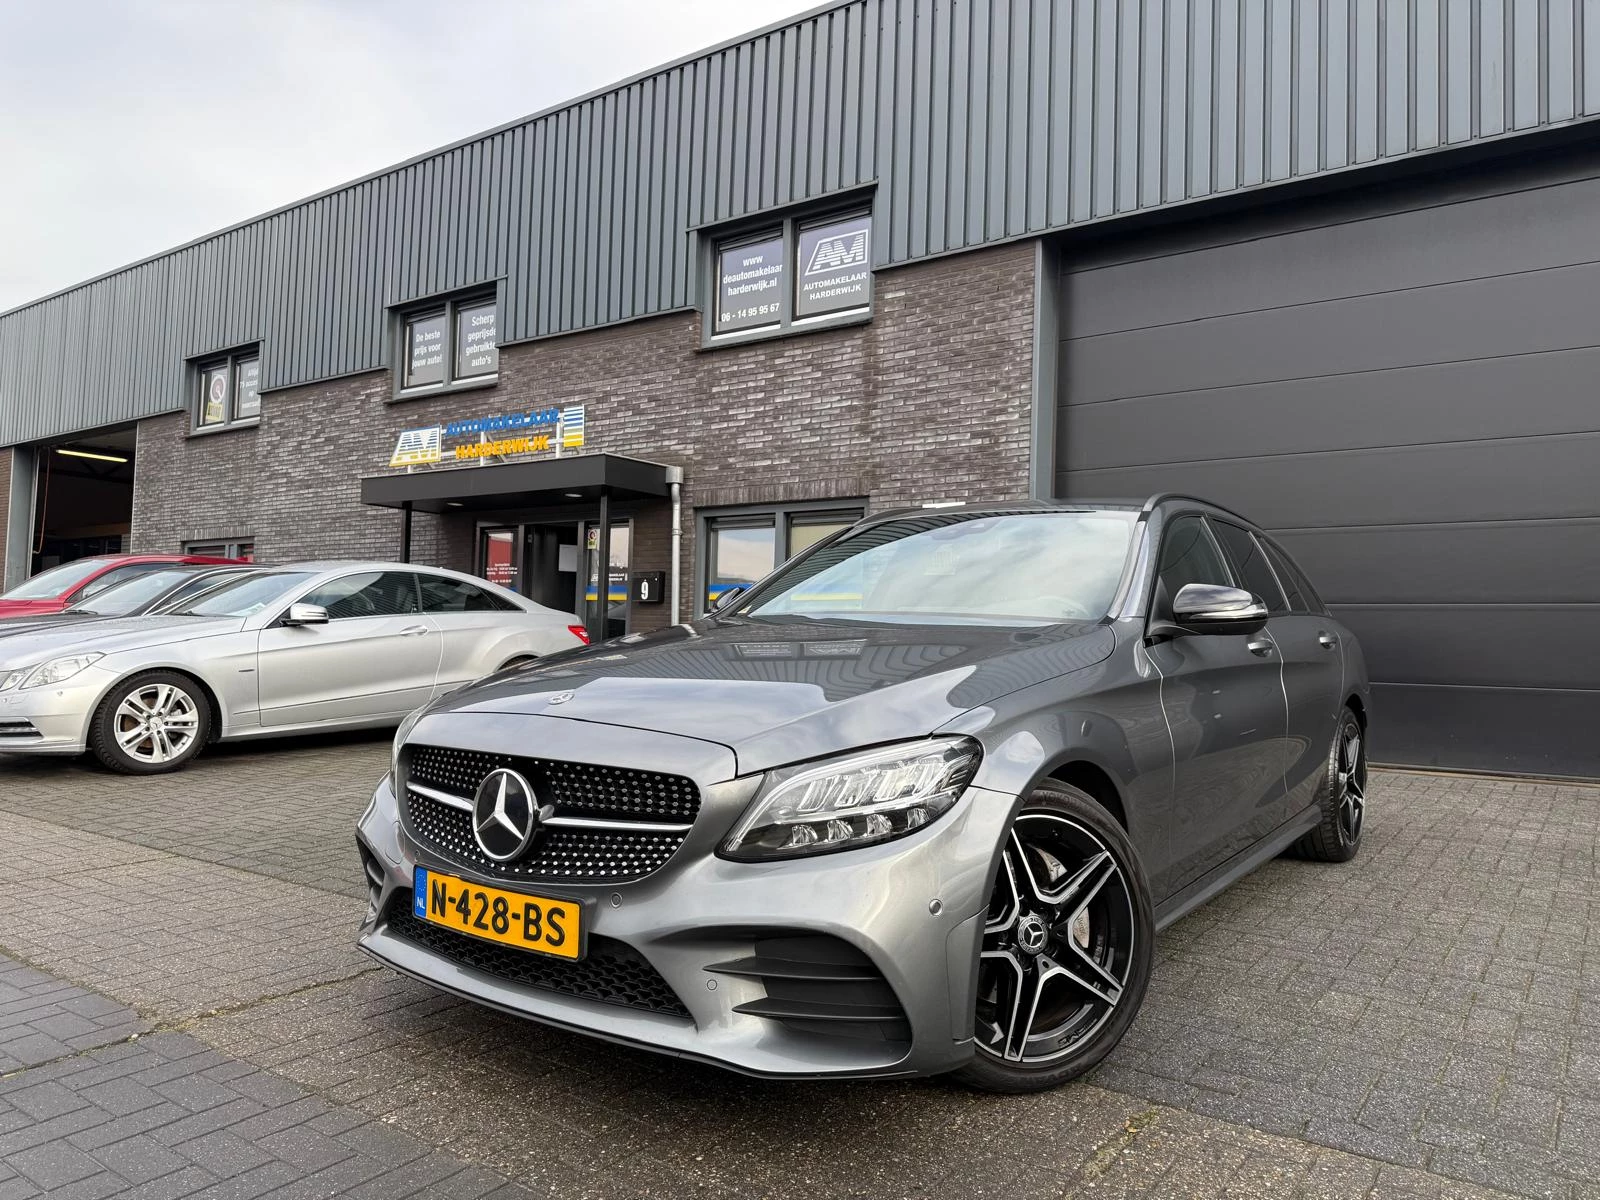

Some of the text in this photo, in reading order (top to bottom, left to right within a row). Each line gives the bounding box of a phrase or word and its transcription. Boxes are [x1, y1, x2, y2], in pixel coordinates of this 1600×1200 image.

[742, 255, 764, 267] www
[723, 264, 783, 284] deautomakelaar
[803, 272, 867, 291] AUTOMAKELAAR
[728, 277, 777, 296] harderwijk.nl
[809, 284, 862, 301] HARDERWIJK
[471, 314, 494, 327] Scherp
[721, 312, 731, 322] 06
[737, 309, 747, 318] 14
[748, 307, 757, 317] 95
[759, 305, 769, 315] 95
[769, 303, 780, 312] 67
[424, 330, 441, 341] beste
[414, 343, 442, 357] prijs voor
[471, 355, 492, 367] auto's
[445, 407, 560, 437] AUTOMAKELAAR
[455, 434, 550, 460] HARDERWIJK
[641, 581, 649, 600] 9
[416, 896, 426, 910] NL
[431, 879, 566, 947] N-428-BS
